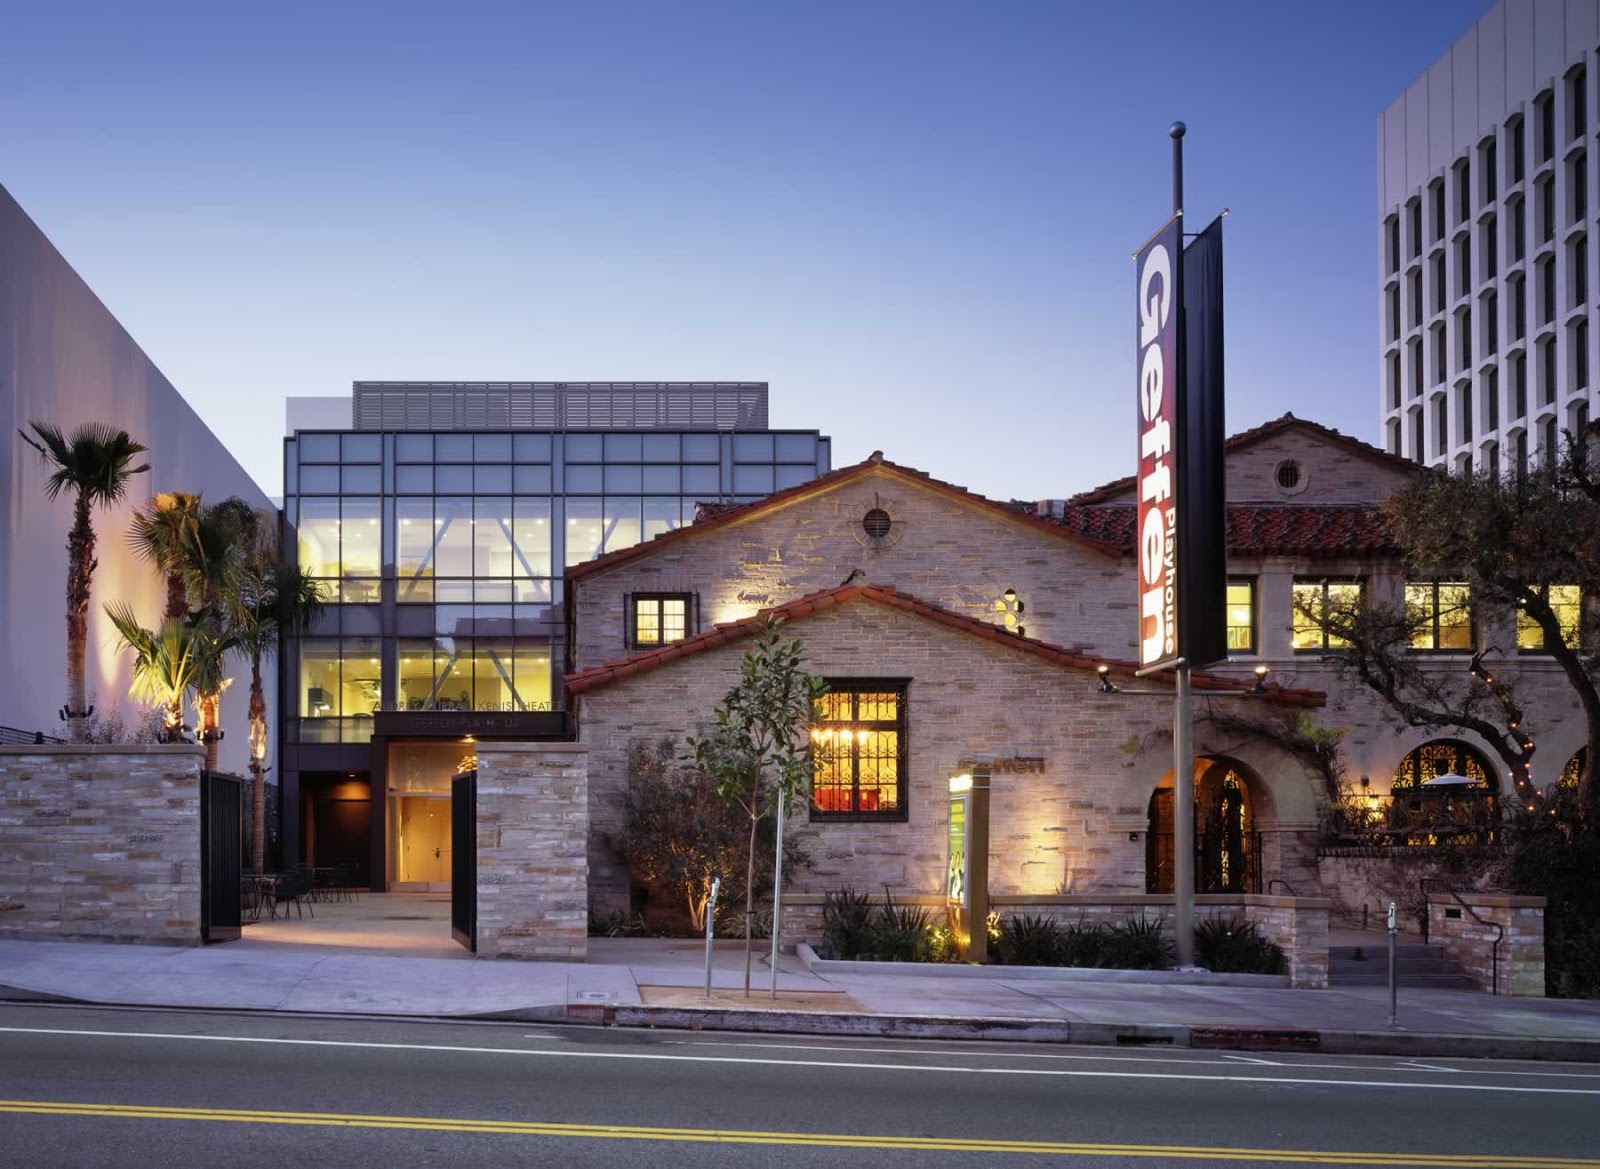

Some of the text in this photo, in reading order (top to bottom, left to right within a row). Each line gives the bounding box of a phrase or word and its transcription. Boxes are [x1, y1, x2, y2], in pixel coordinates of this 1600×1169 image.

[1140, 244, 1171, 665] Geffen
[1164, 507, 1176, 655] Playhouse
[372, 701, 419, 711] ADREY
[477, 701, 513, 711] KENIS
[518, 701, 564, 711] HEATE
